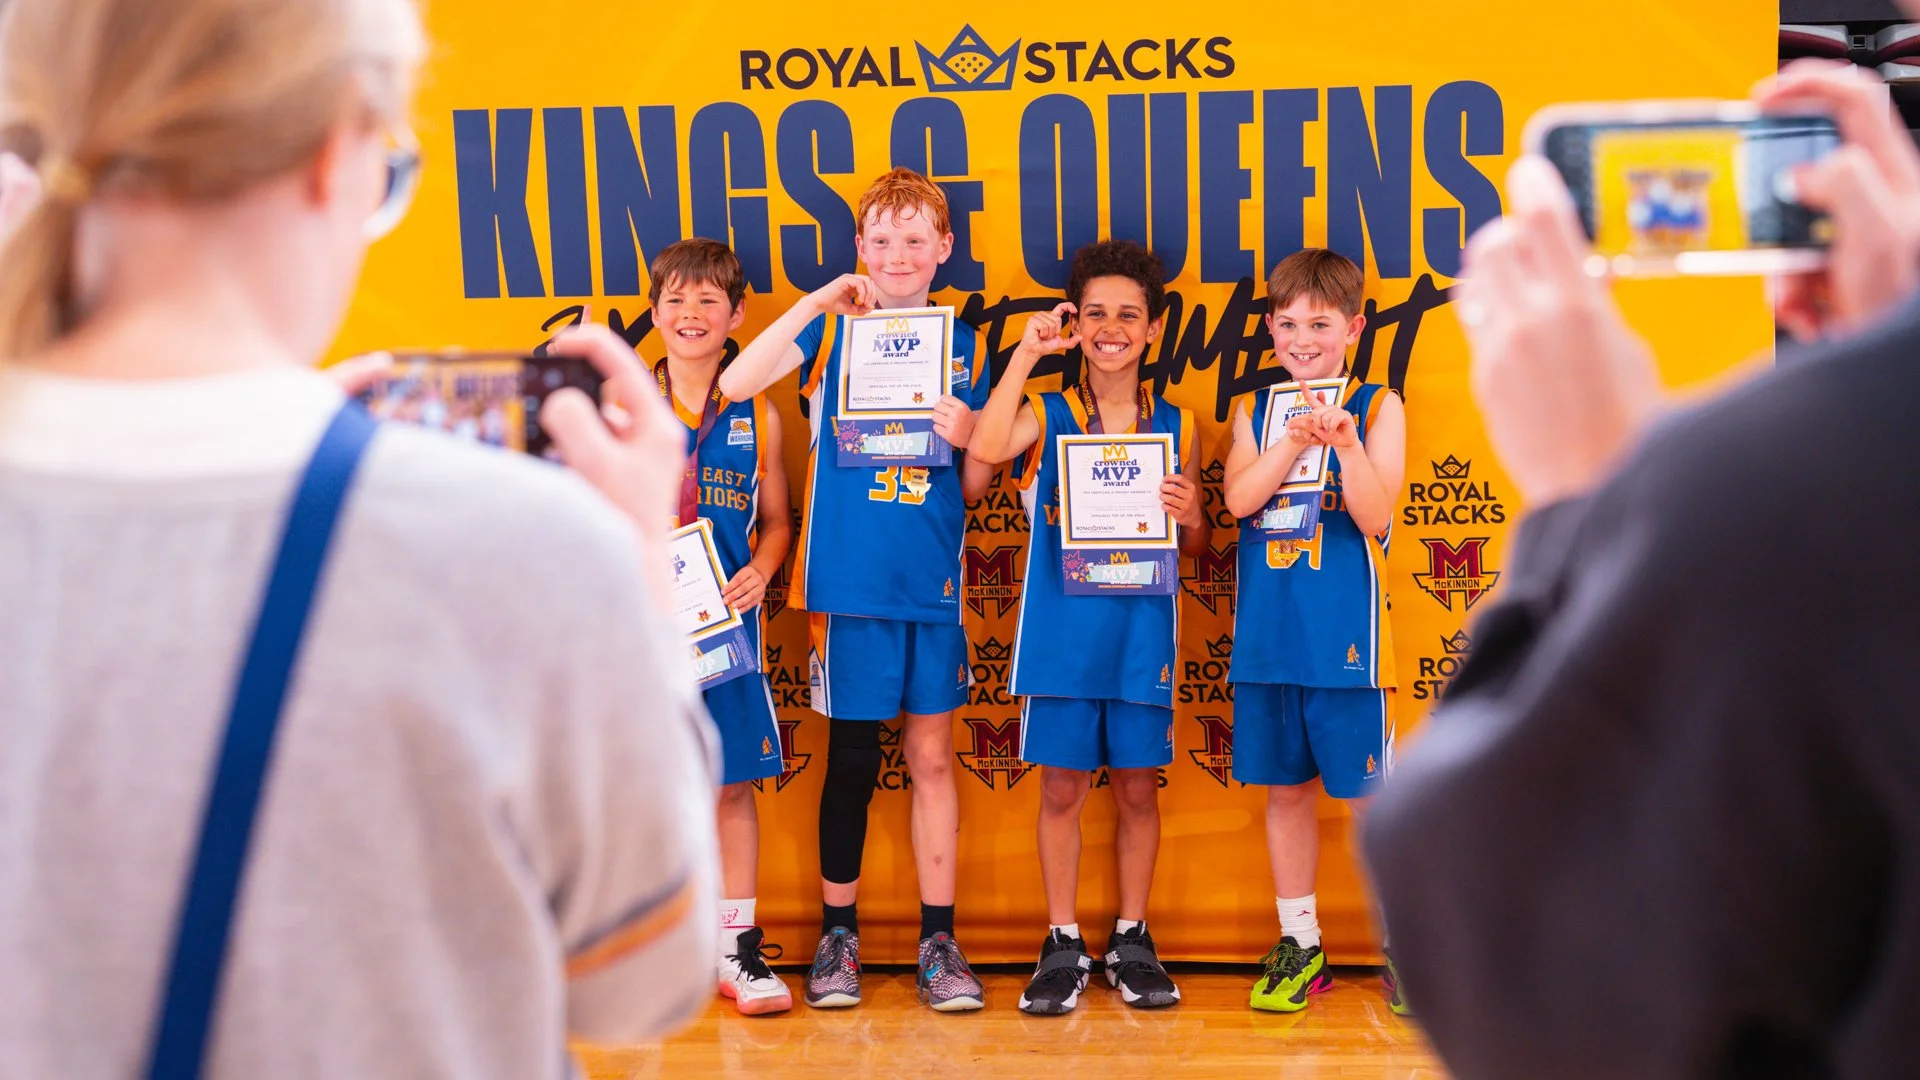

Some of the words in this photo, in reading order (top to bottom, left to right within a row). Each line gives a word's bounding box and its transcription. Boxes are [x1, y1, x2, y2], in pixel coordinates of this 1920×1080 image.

[740, 45, 916, 90] ROYAL
[1023, 36, 1235, 84] STACKS
[452, 100, 856, 299] KINGS
[1018, 80, 1504, 290] QUEENS
[876, 330, 918, 339] crowned
[872, 338, 921, 352] MVP
[876, 437, 914, 451] MVP
[1094, 459, 1138, 467] crowned
[702, 466, 747, 488] EAST
[1092, 467, 1141, 480] MVP
[1409, 481, 1497, 503] ROYAL
[1270, 512, 1295, 526] MVP
[1403, 503, 1506, 526] STACKS
[964, 513, 1031, 533] ACKS
[1102, 567, 1140, 581] MVP
[1434, 578, 1480, 589] McKINNON
[967, 586, 1012, 597] McKINNON
[768, 665, 807, 686] YAL
[977, 757, 1023, 768] McKINNON
[1210, 756, 1232, 766] McKI
[1077, 955, 1092, 970] NIKE
[1105, 950, 1121, 966] NIKE
